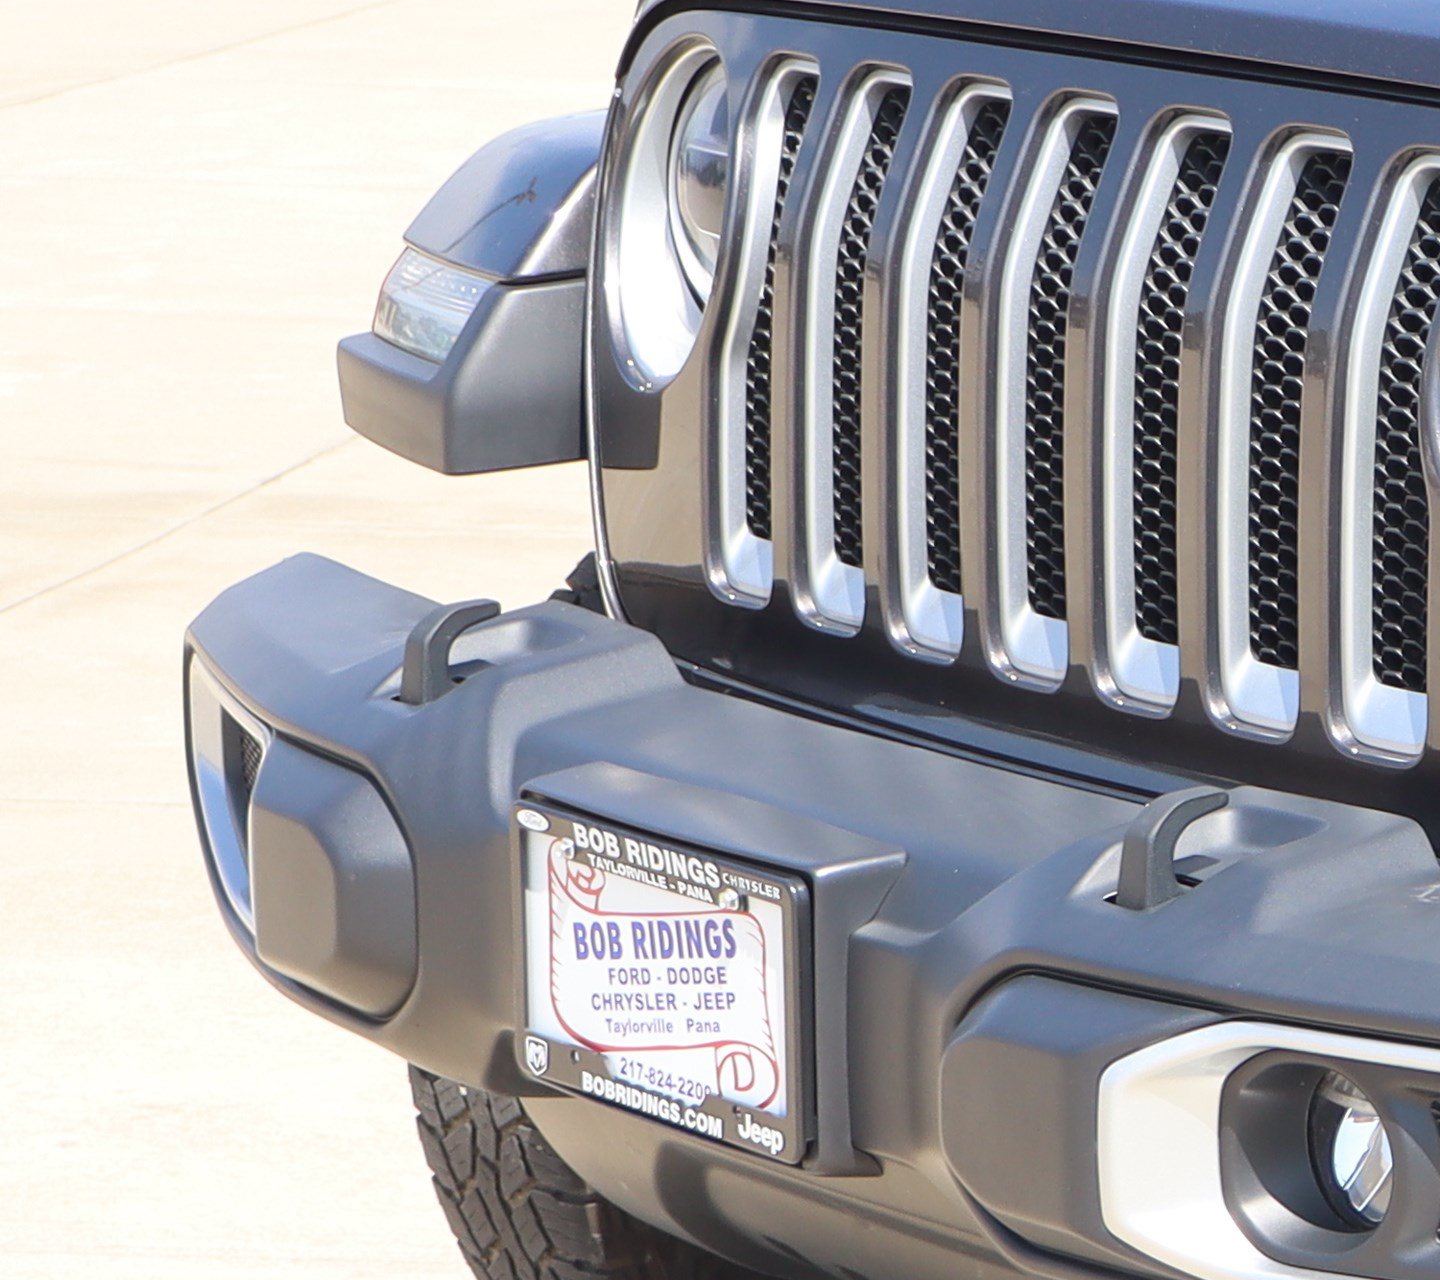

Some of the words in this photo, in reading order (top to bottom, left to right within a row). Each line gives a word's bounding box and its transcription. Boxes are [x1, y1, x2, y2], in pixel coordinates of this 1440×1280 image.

[572, 821, 621, 859] BOB
[626, 837, 721, 890] RIDINGS
[586, 853, 668, 891] TAYLORVILLE
[677, 880, 714, 905] PANA
[721, 871, 782, 901] CHRYSLER
[572, 921, 623, 961] BOB
[632, 918, 738, 961] RIDINGS
[607, 966, 653, 986] FORD
[667, 965, 728, 987] DODGE
[590, 992, 678, 1012] CHRYSLER
[692, 992, 737, 1012] JEEP
[605, 1018, 674, 1038] Taylorville
[686, 1018, 722, 1034] Pana
[581, 1070, 724, 1139] BOBRIDINGS.COM
[736, 1112, 785, 1155] Jeep
